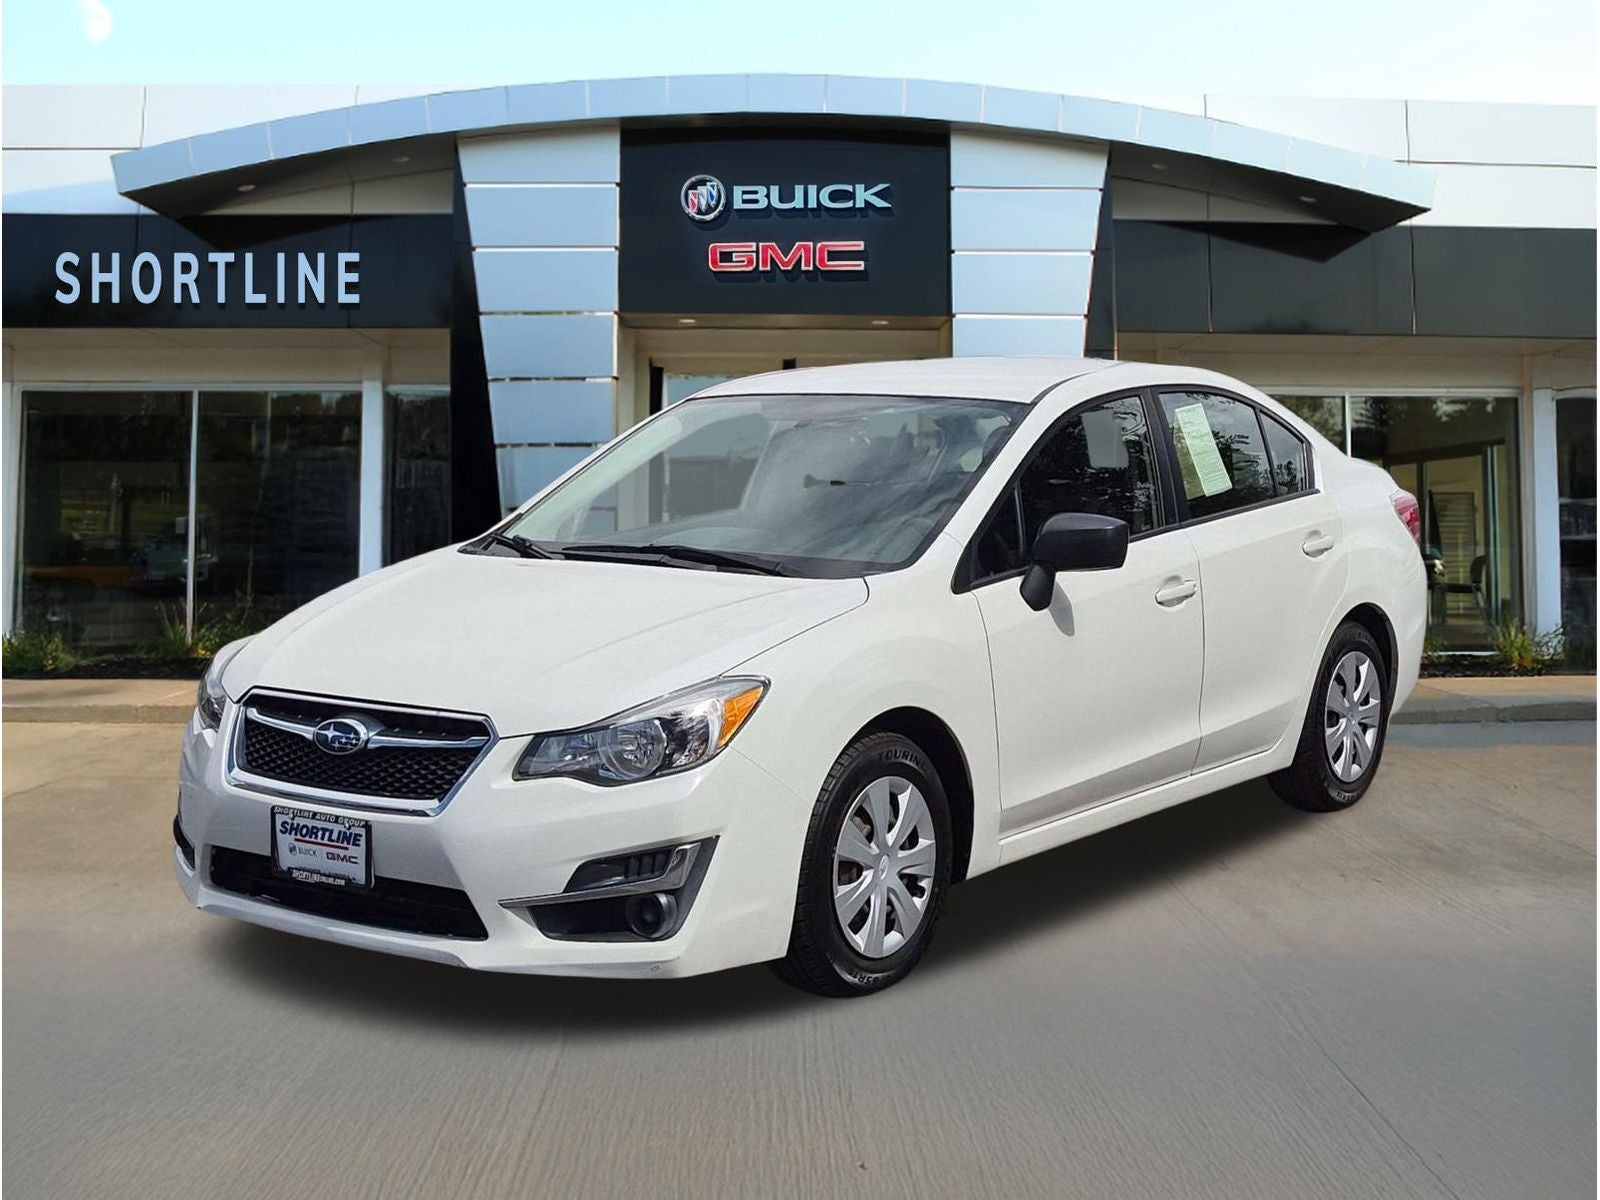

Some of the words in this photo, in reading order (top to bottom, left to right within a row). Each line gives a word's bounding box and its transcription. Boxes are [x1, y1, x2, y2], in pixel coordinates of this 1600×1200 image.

[733, 183, 893, 210] BUICK
[708, 240, 865, 272] GMC
[55, 251, 361, 305] SHORTLINE
[274, 806, 313, 819] SHORTLINE
[315, 813, 334, 822] AUTO
[338, 817, 366, 828] GROUP
[279, 820, 363, 848] SHORTLINE
[326, 851, 359, 865] GMC
